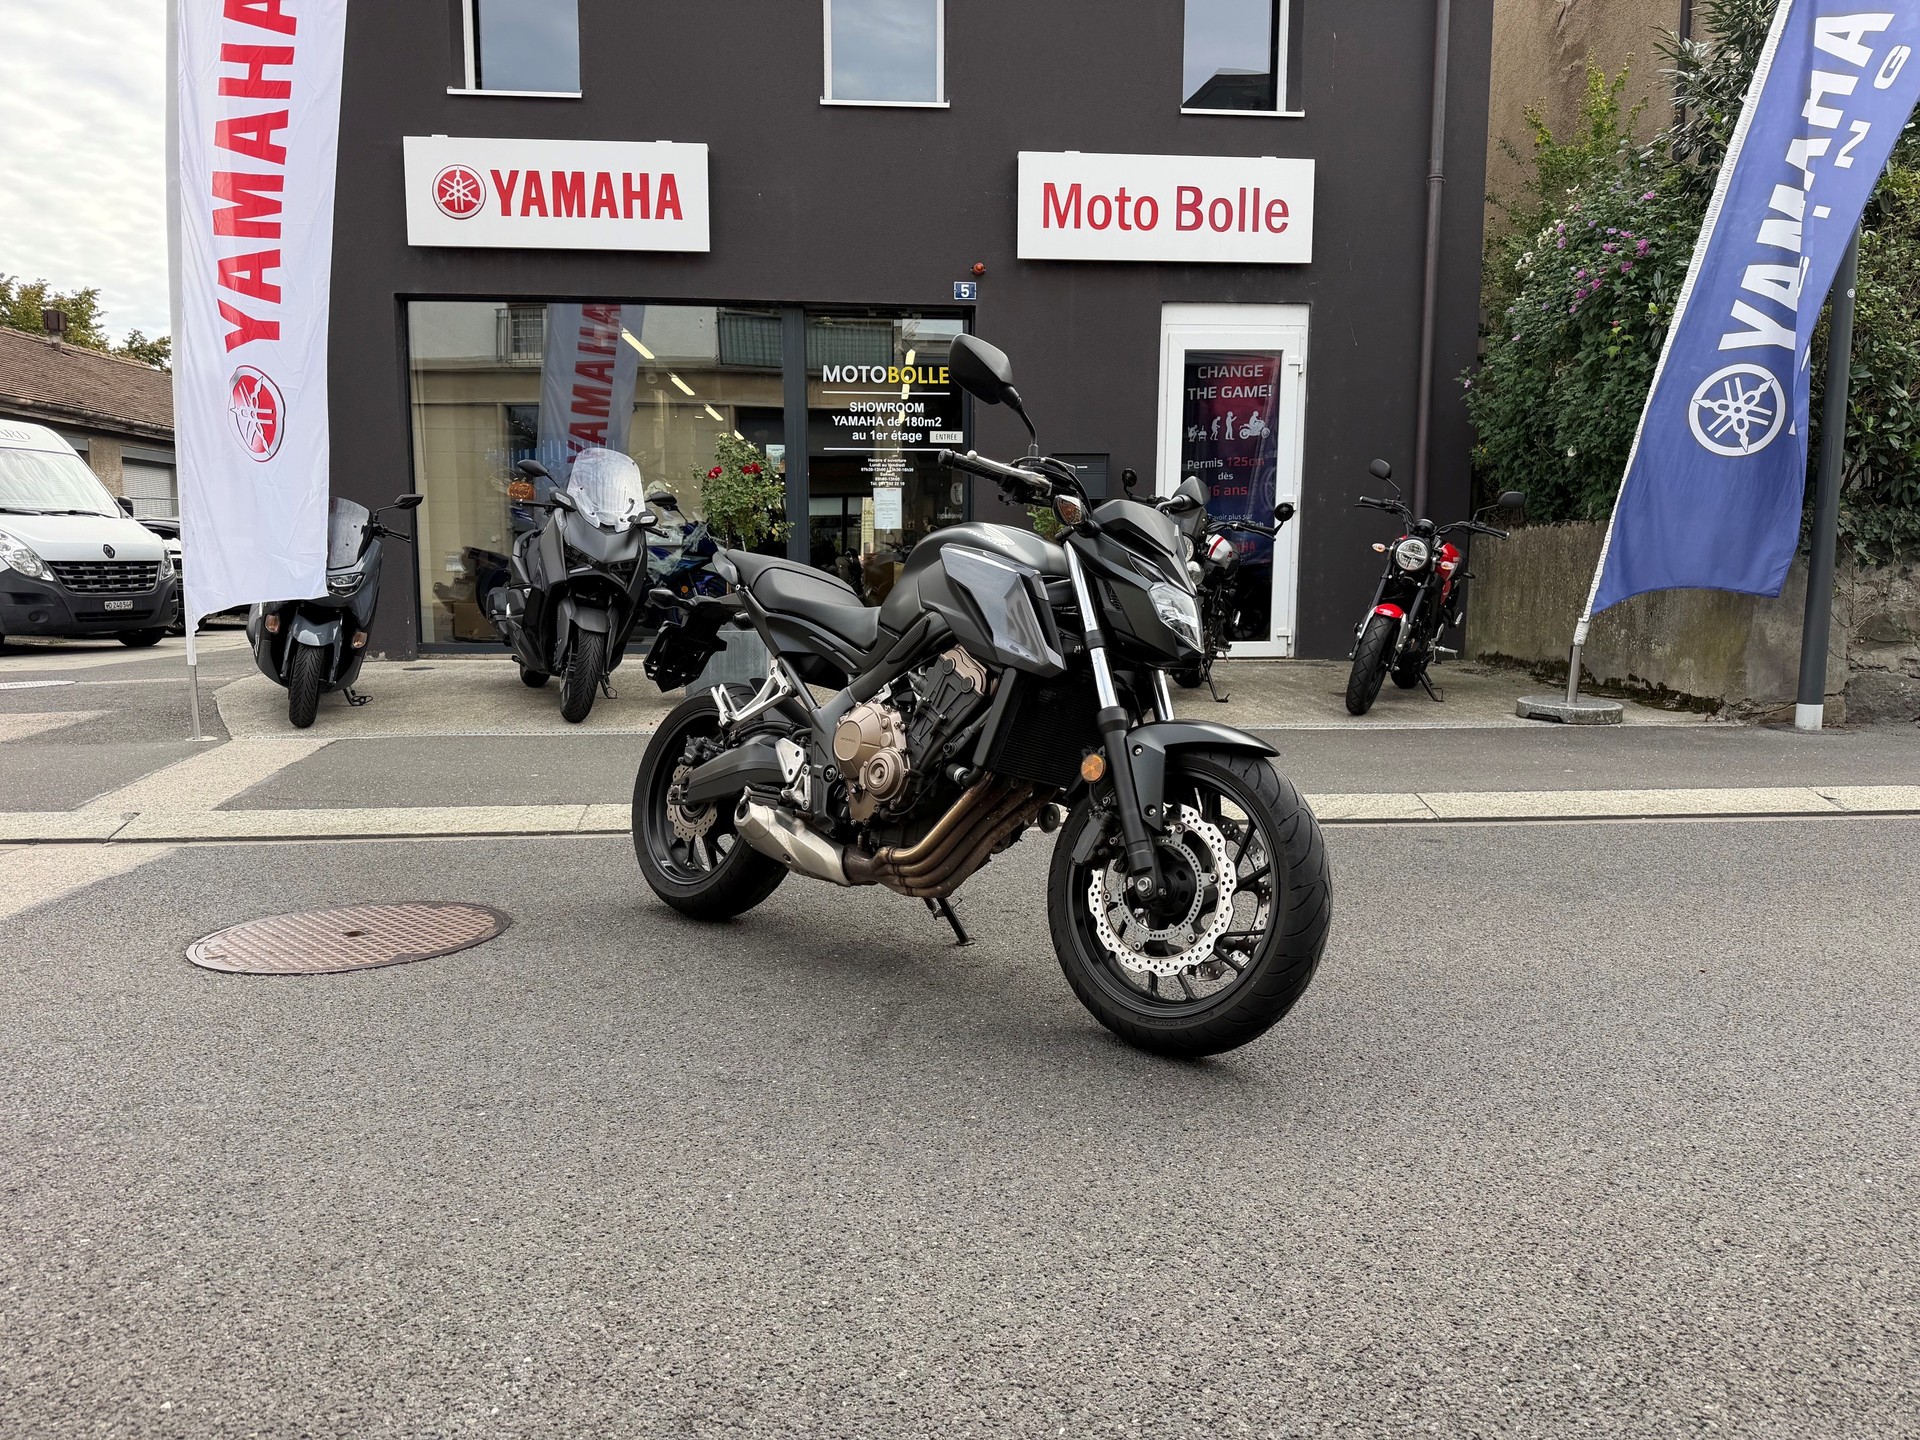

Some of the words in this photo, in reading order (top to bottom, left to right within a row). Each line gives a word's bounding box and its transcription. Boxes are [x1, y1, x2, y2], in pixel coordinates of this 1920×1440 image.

[211, 0, 298, 354] YAMAHA
[490, 169, 683, 220] YAMAHA
[1043, 183, 1159, 231] Moto
[1176, 185, 1289, 233] Bolle
[961, 284, 970, 298] 5
[1197, 364, 1264, 379] CHANGE
[1187, 386, 1217, 400] THE
[1221, 384, 1272, 398] GAME!
[849, 402, 924, 413] SHOWROOM
[832, 416, 884, 427] YAMAHA
[887, 416, 900, 427] de
[905, 417, 942, 427] 180m2
[852, 432, 866, 440] au
[870, 430, 888, 440] 1er
[891, 430, 923, 443] étage
[935, 432, 958, 440] ENTRÉE
[1187, 456, 1224, 470] Permis
[1217, 472, 1234, 481] dès
[1224, 486, 1248, 496] ans
[1228, 513, 1242, 521] plus
